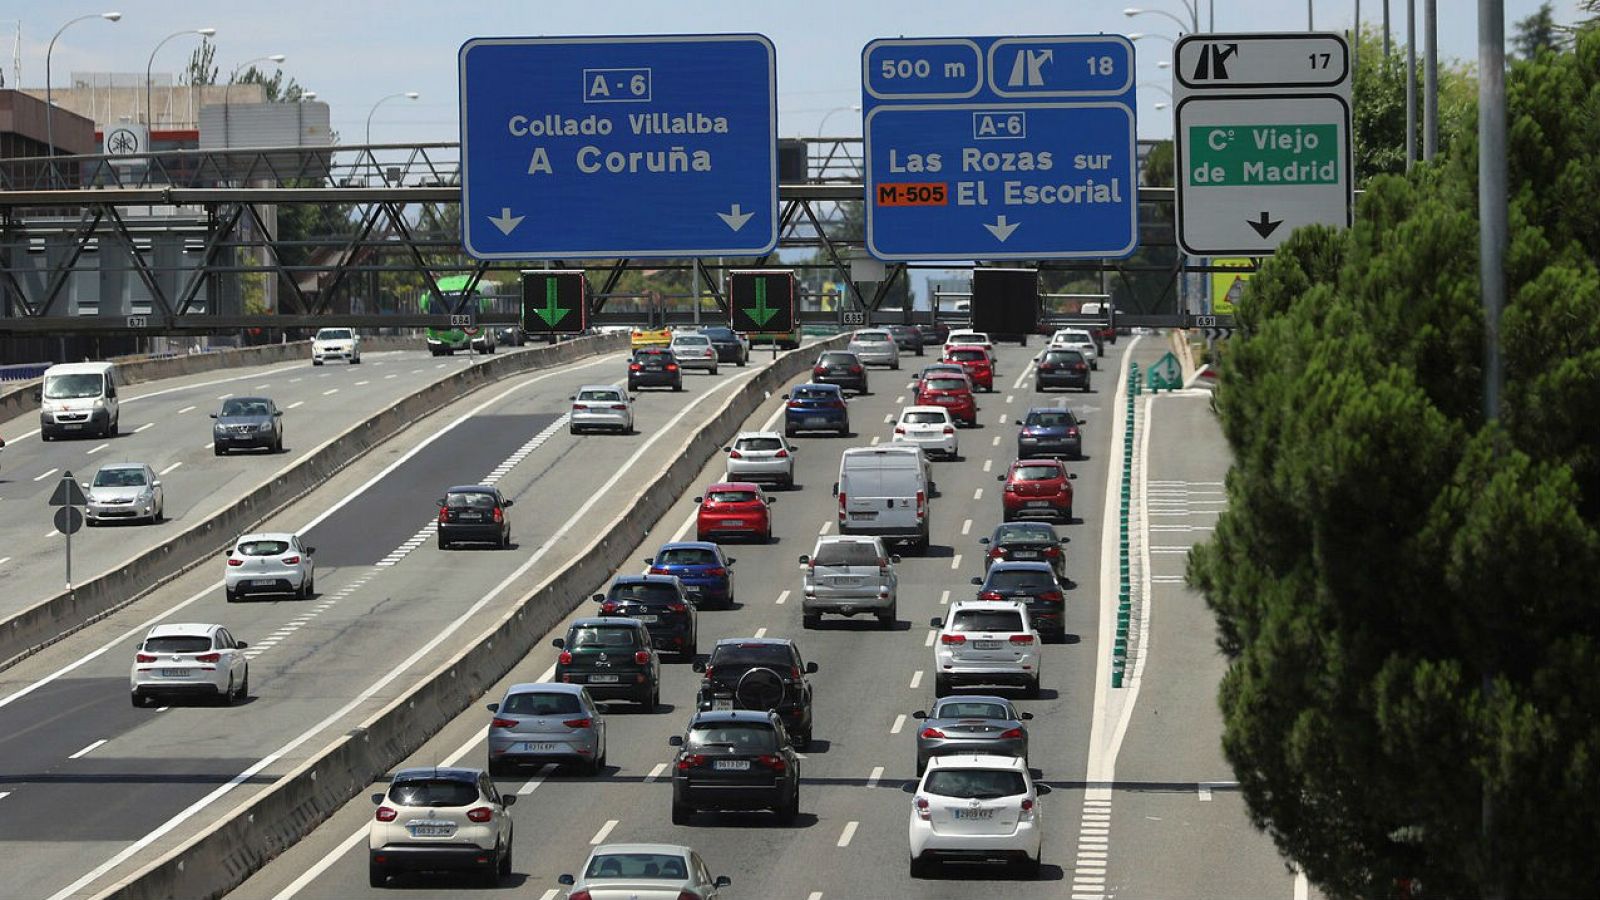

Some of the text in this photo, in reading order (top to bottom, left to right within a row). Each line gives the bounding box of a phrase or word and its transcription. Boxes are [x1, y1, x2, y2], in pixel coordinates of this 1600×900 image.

[881, 59, 966, 79] 500 m
[1086, 56, 1114, 76] 18
[1308, 53, 1331, 70] 17
[508, 112, 728, 136] Collado Villalba
[978, 115, 1021, 135] A-6
[1253, 128, 1319, 153] Viejo
[527, 146, 712, 174] A Coruña
[889, 148, 1112, 173] Las Rozas sur
[1193, 160, 1335, 183] de Madrid
[879, 178, 1122, 206] M-505 El Escorial
